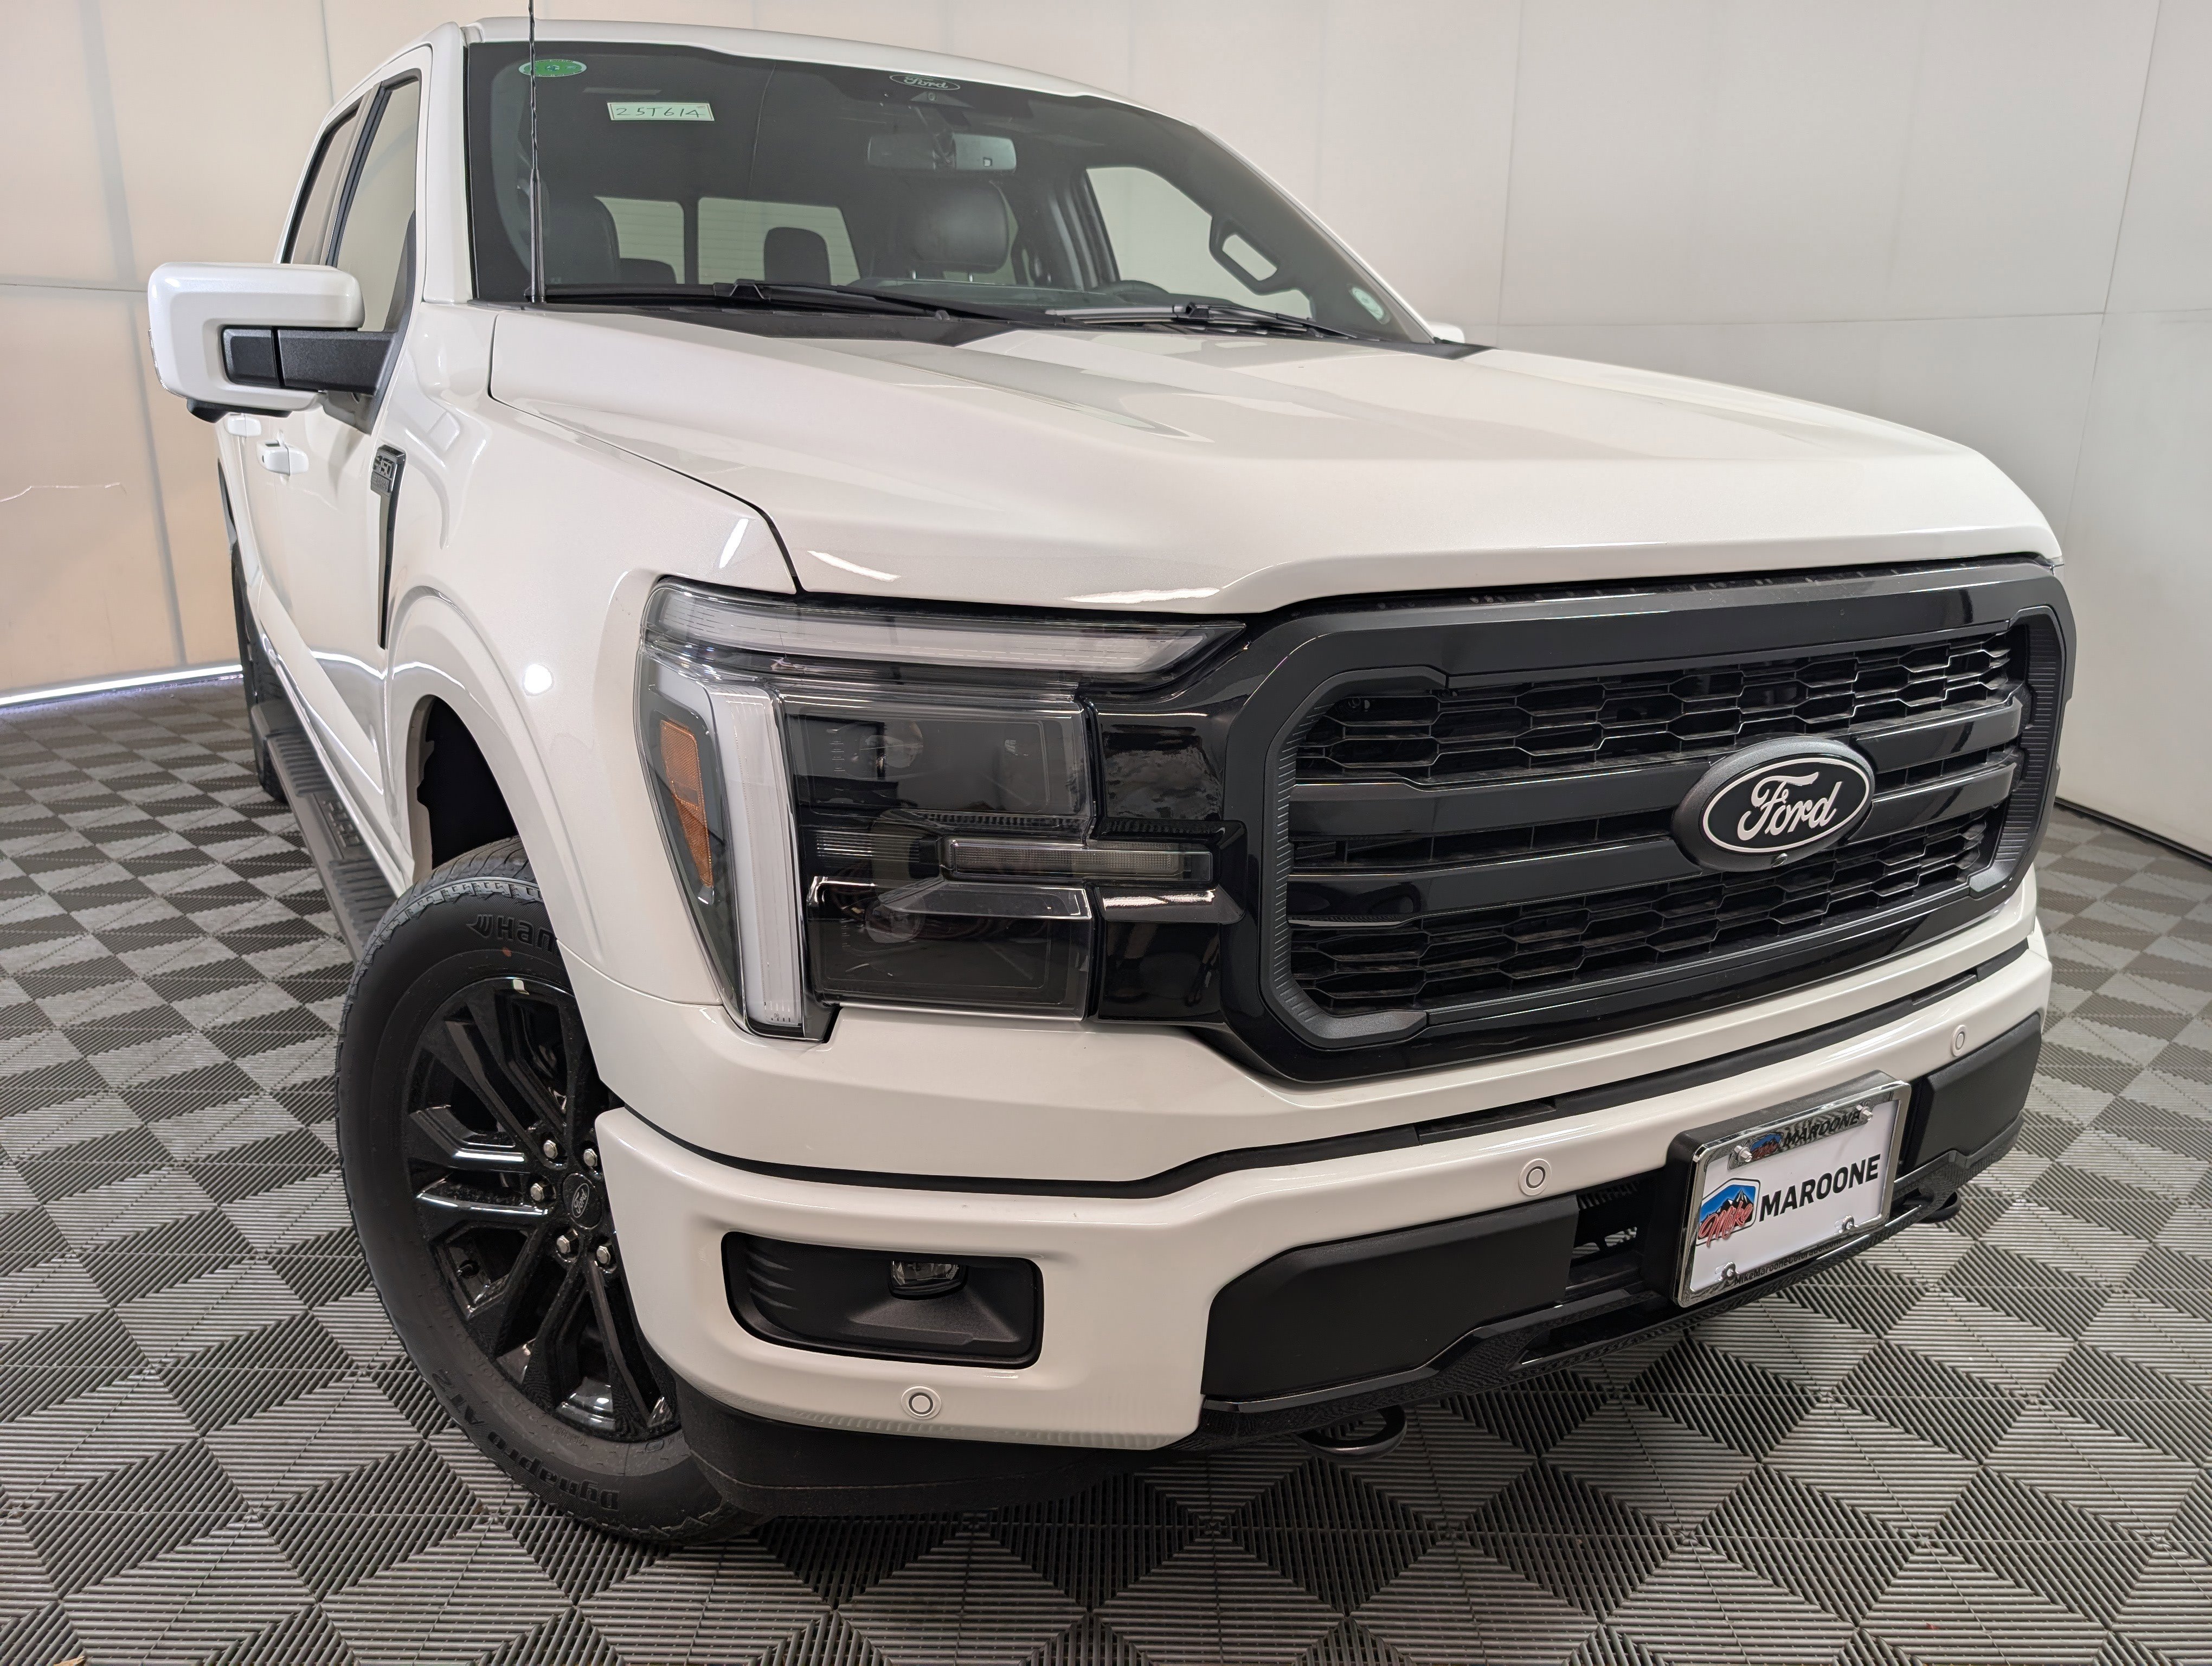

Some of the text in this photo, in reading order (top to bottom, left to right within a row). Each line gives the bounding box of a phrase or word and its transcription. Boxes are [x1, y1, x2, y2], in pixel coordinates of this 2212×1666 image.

[904, 76, 948, 88] Ford
[1737, 771, 1843, 841] Ford
[497, 915, 557, 955] Han
[1783, 1110, 1860, 1147] MAROONE
[574, 1189, 587, 1214] Ford
[1698, 1154, 1881, 1248] Mike MAROONE
